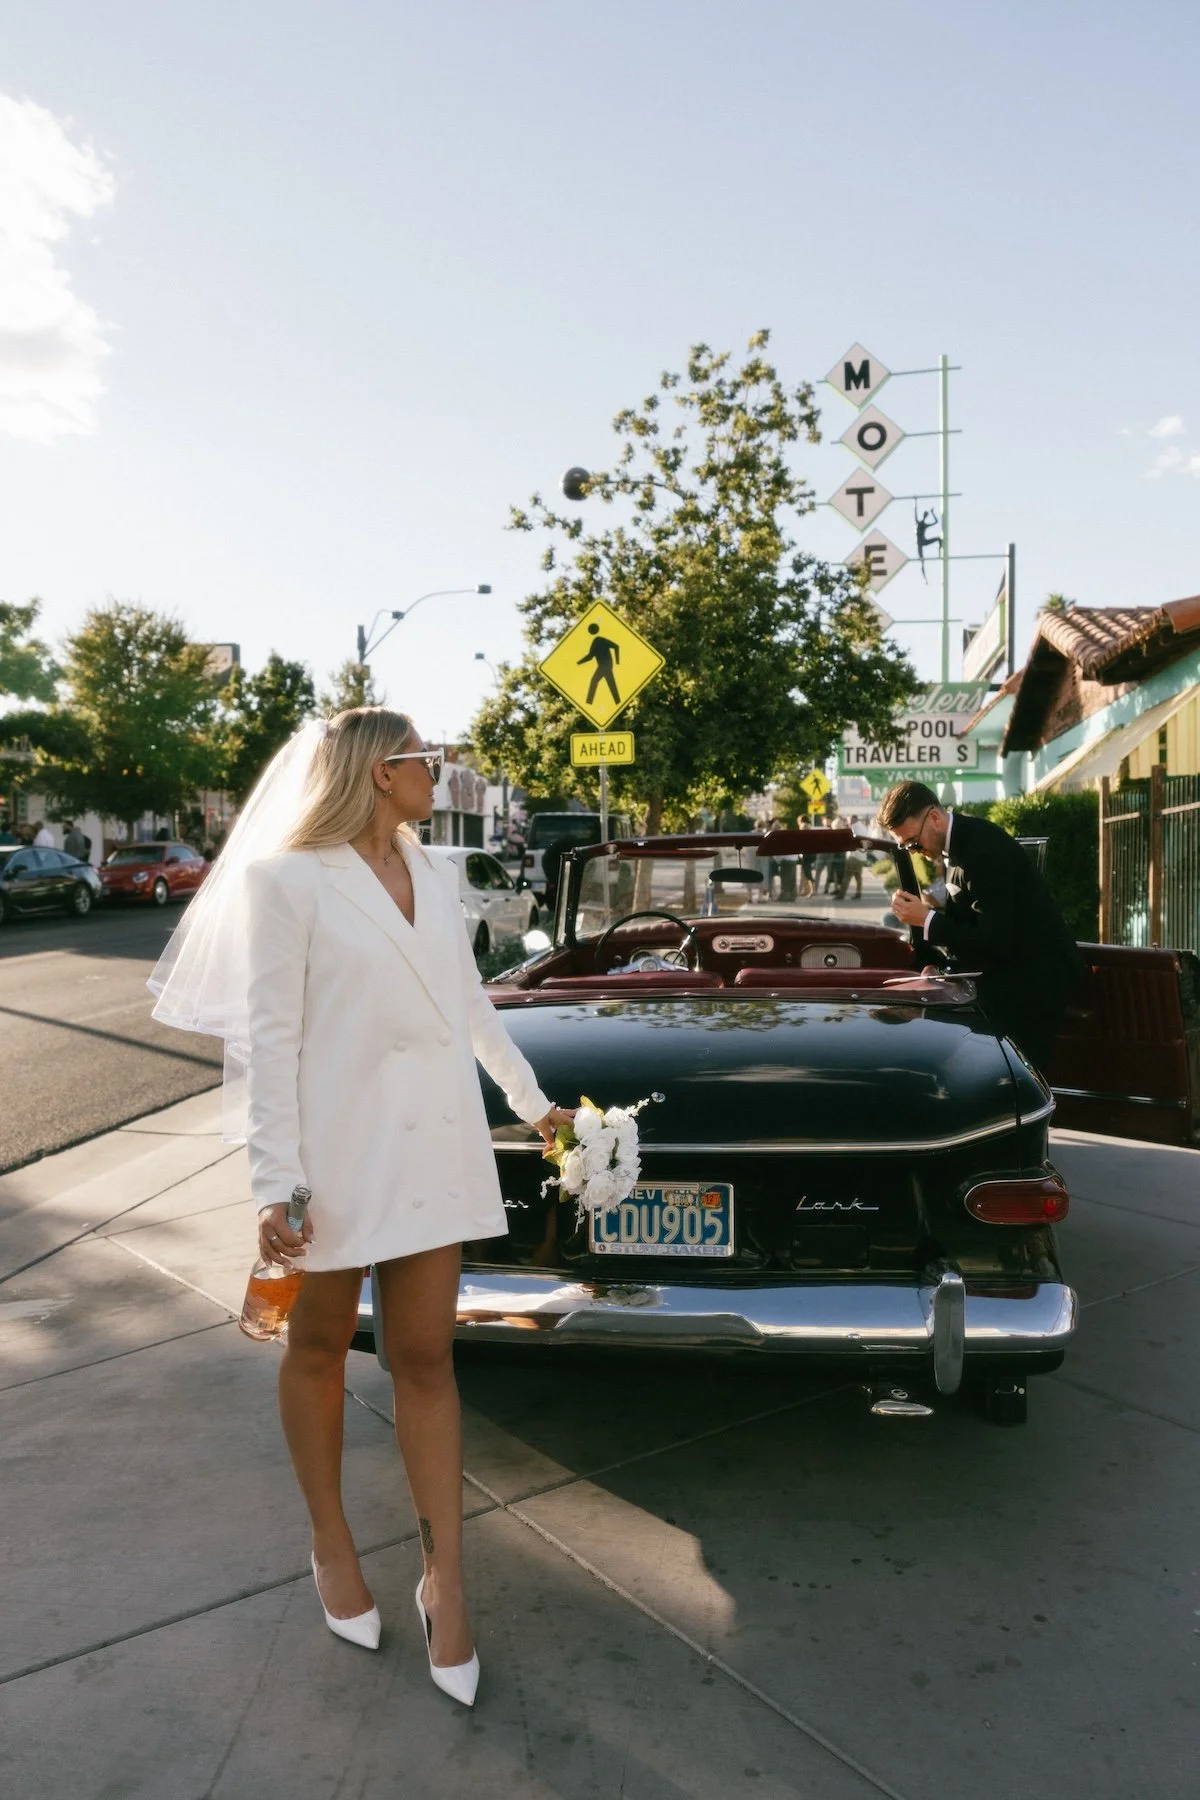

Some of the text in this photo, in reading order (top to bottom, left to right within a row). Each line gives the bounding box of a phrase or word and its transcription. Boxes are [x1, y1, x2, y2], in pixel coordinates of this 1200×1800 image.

[844, 359, 888, 577] MOTE
[906, 720, 959, 737] POOL
[579, 741, 626, 757] AHEAD
[844, 744, 968, 763] TRAVELER S
[796, 1196, 879, 1210] Lark
[600, 1203, 723, 1245] CDU905
